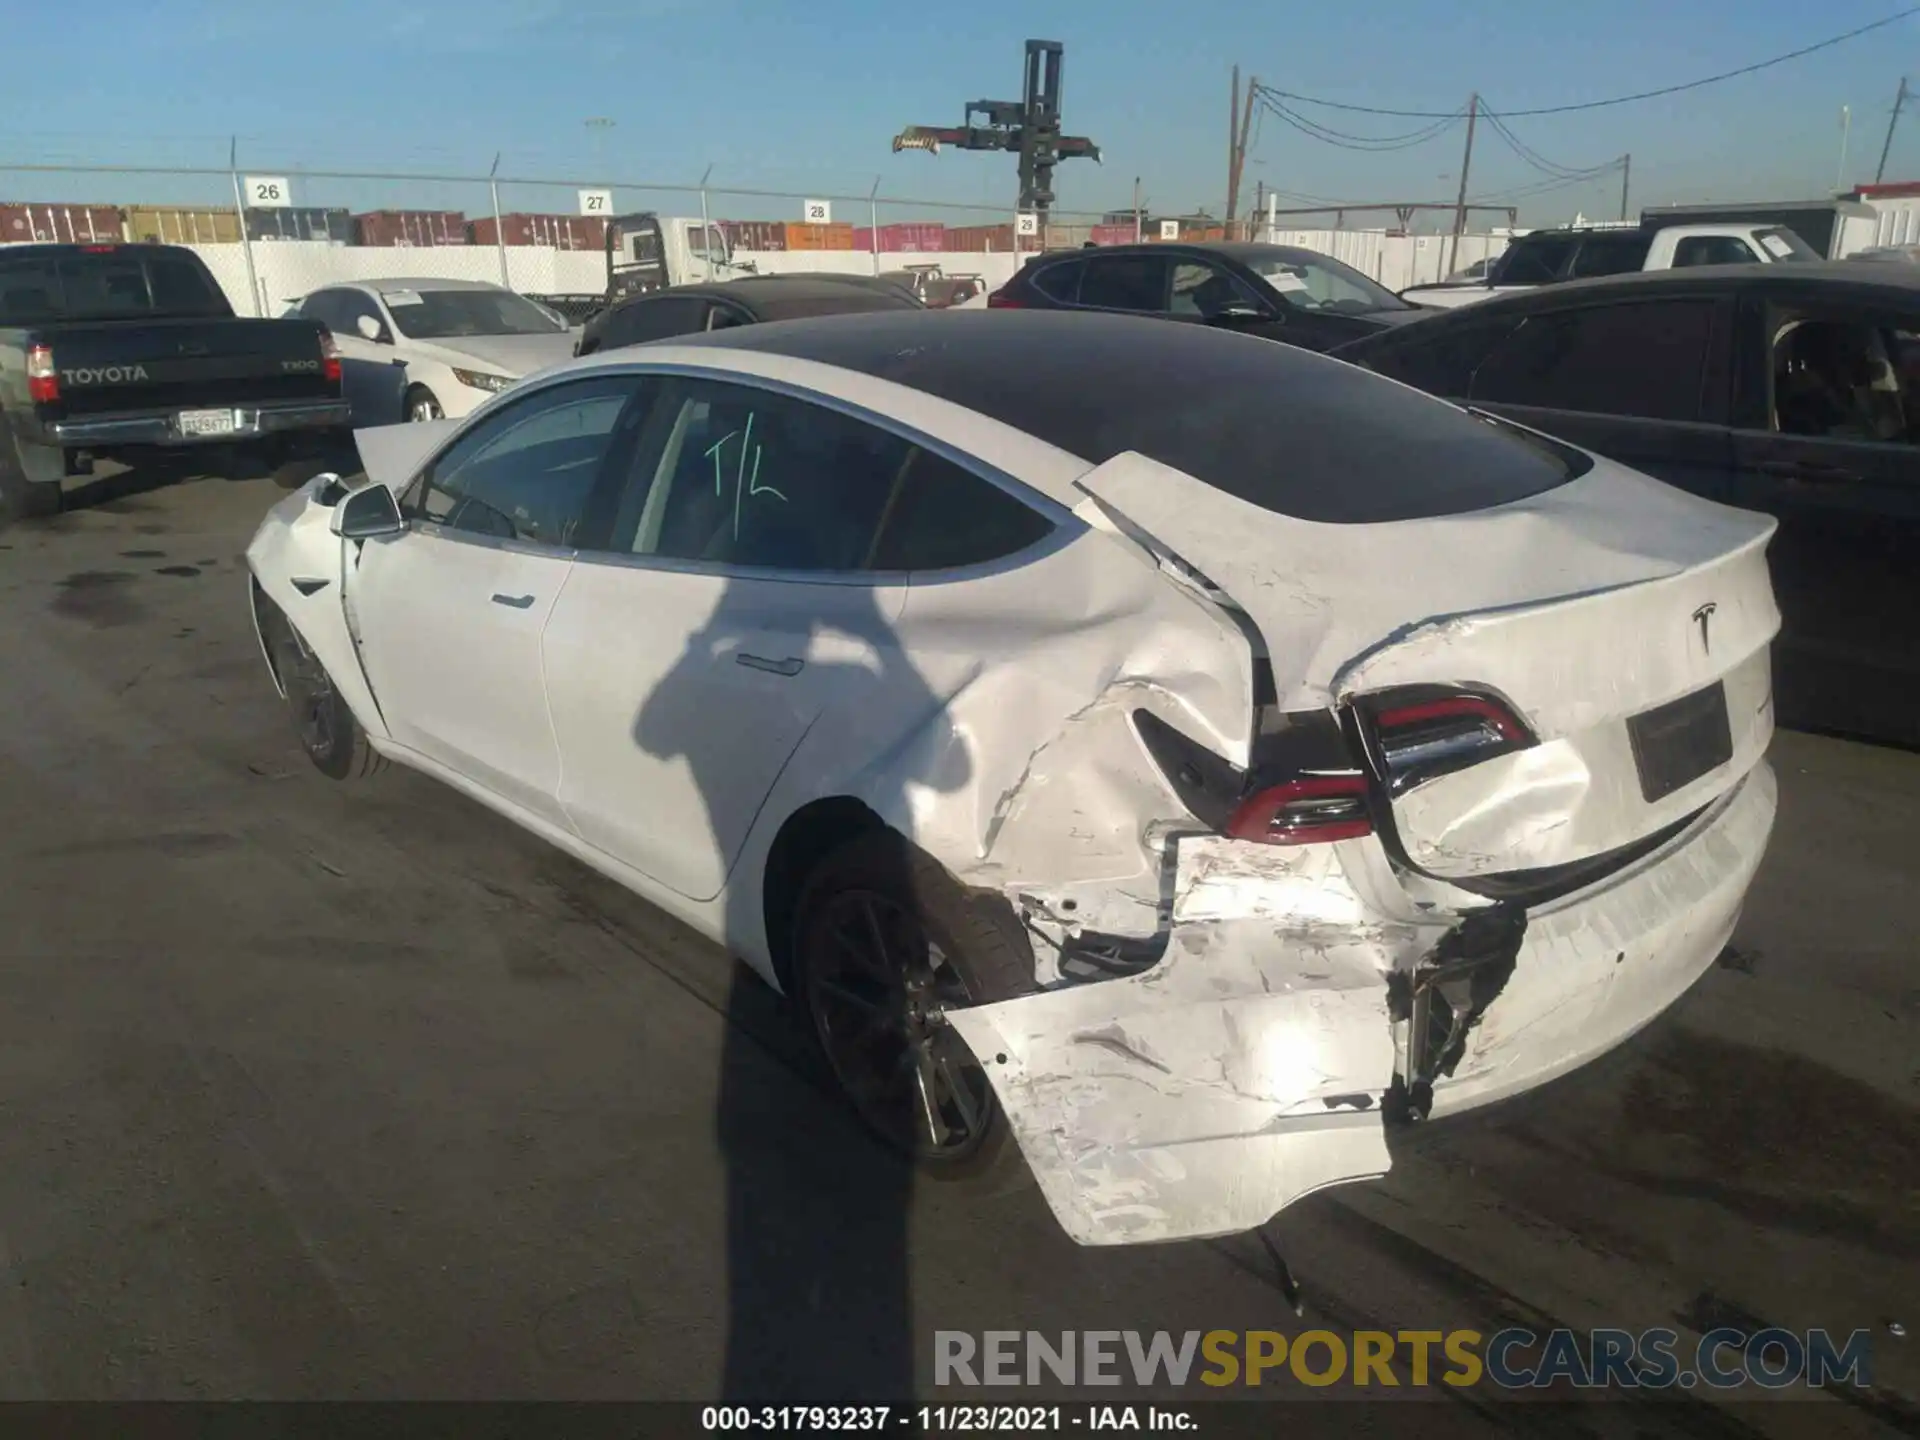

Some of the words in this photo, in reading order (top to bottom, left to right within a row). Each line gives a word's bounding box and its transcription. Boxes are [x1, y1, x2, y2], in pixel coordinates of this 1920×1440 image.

[257, 184, 280, 200] 26
[587, 196, 604, 210] 27
[810, 206, 825, 218] 28
[62, 366, 148, 385] TOYOTA
